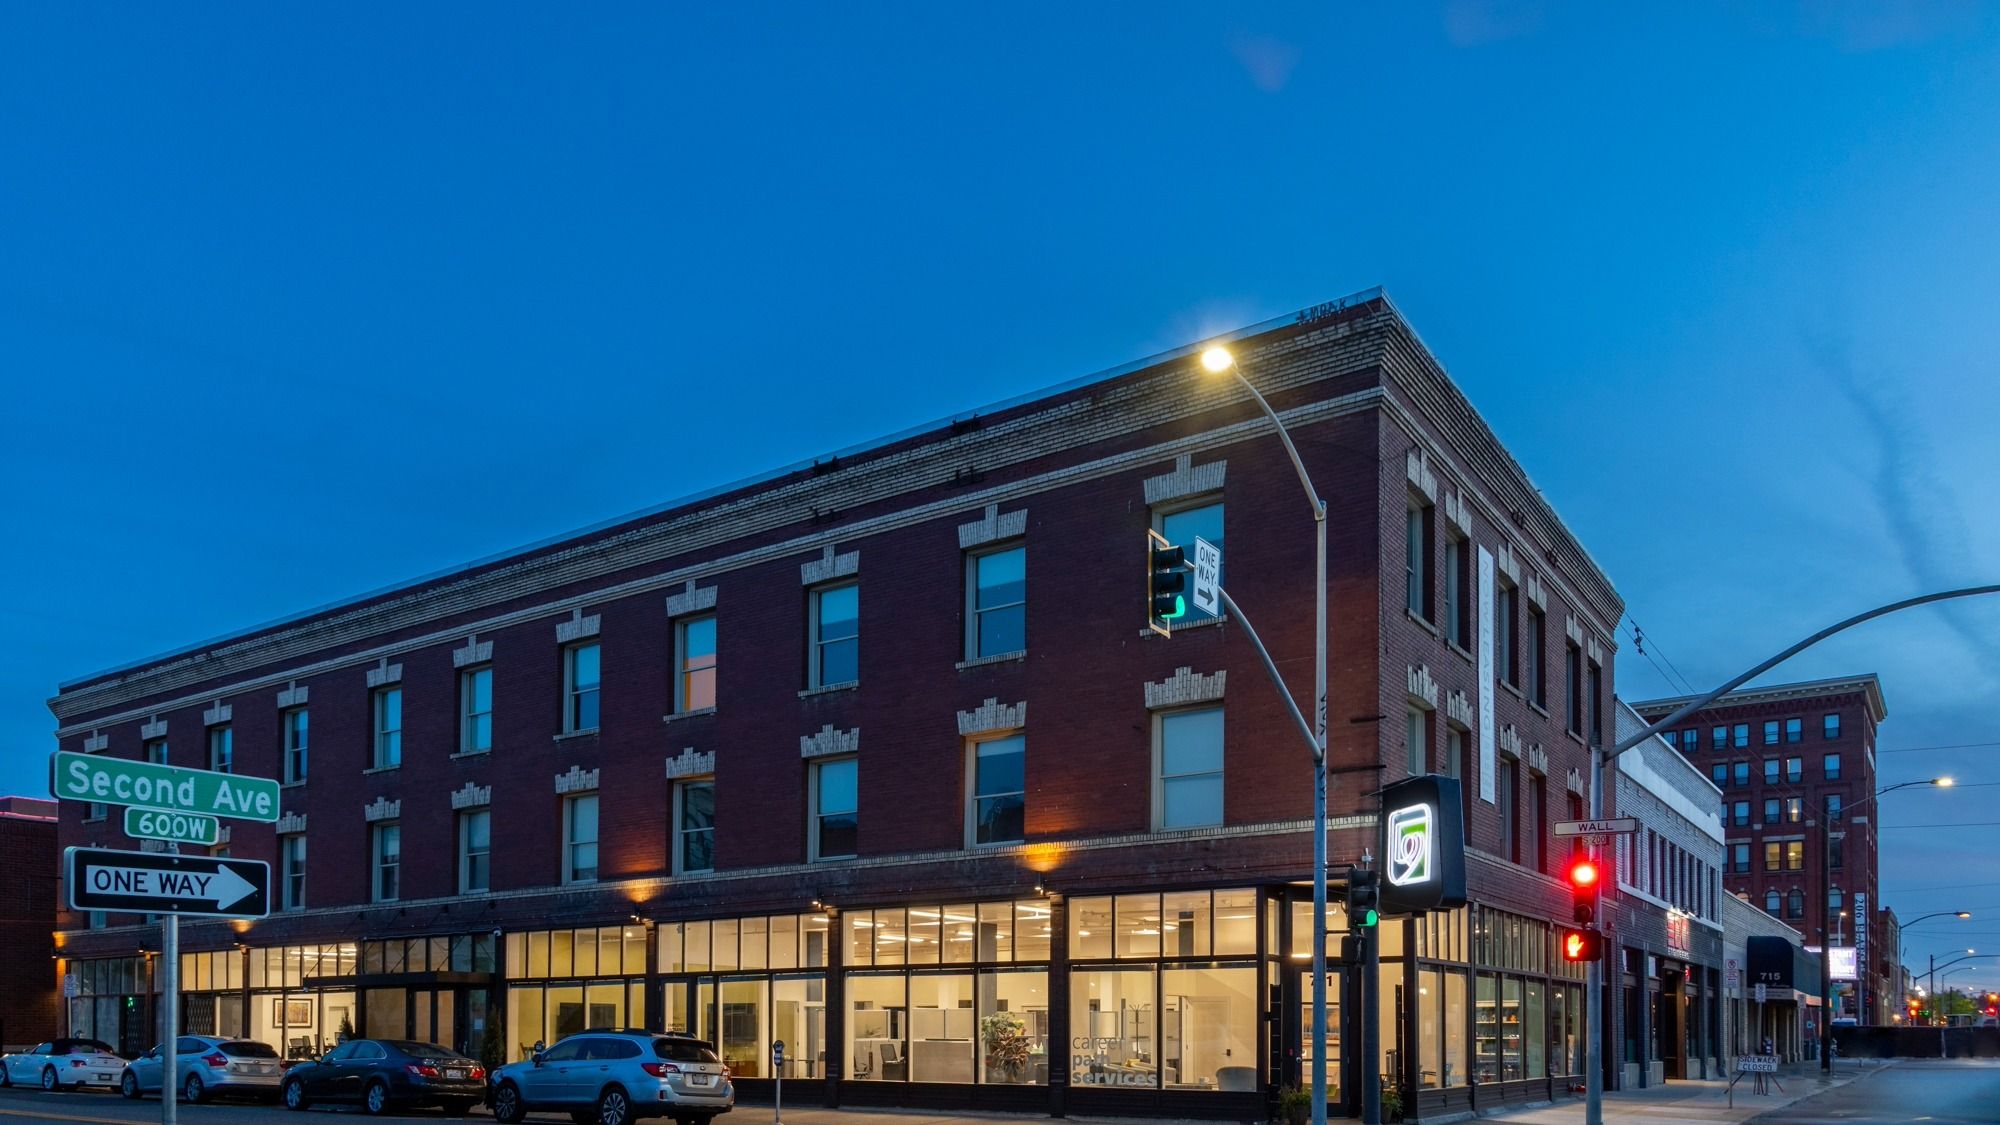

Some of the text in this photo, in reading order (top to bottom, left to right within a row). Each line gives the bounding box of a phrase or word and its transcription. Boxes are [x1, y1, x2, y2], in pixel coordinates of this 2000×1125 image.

[1199, 546, 1216, 569] ONE
[1197, 563, 1217, 587] WAY
[67, 760, 272, 815] Second Ave
[139, 813, 207, 839] 600W
[1578, 822, 1614, 831] WALL
[94, 869, 212, 896] ONE WAY
[1855, 898, 1864, 919] 206
[1309, 975, 1333, 987] 71
[1760, 972, 1781, 981] 715
[1072, 1036, 1123, 1050] career
[1072, 1052, 1111, 1070] path
[1740, 1056, 1777, 1064] SIDEWALK
[1742, 1063, 1773, 1071] CLOSED
[1072, 1068, 1158, 1086] services
